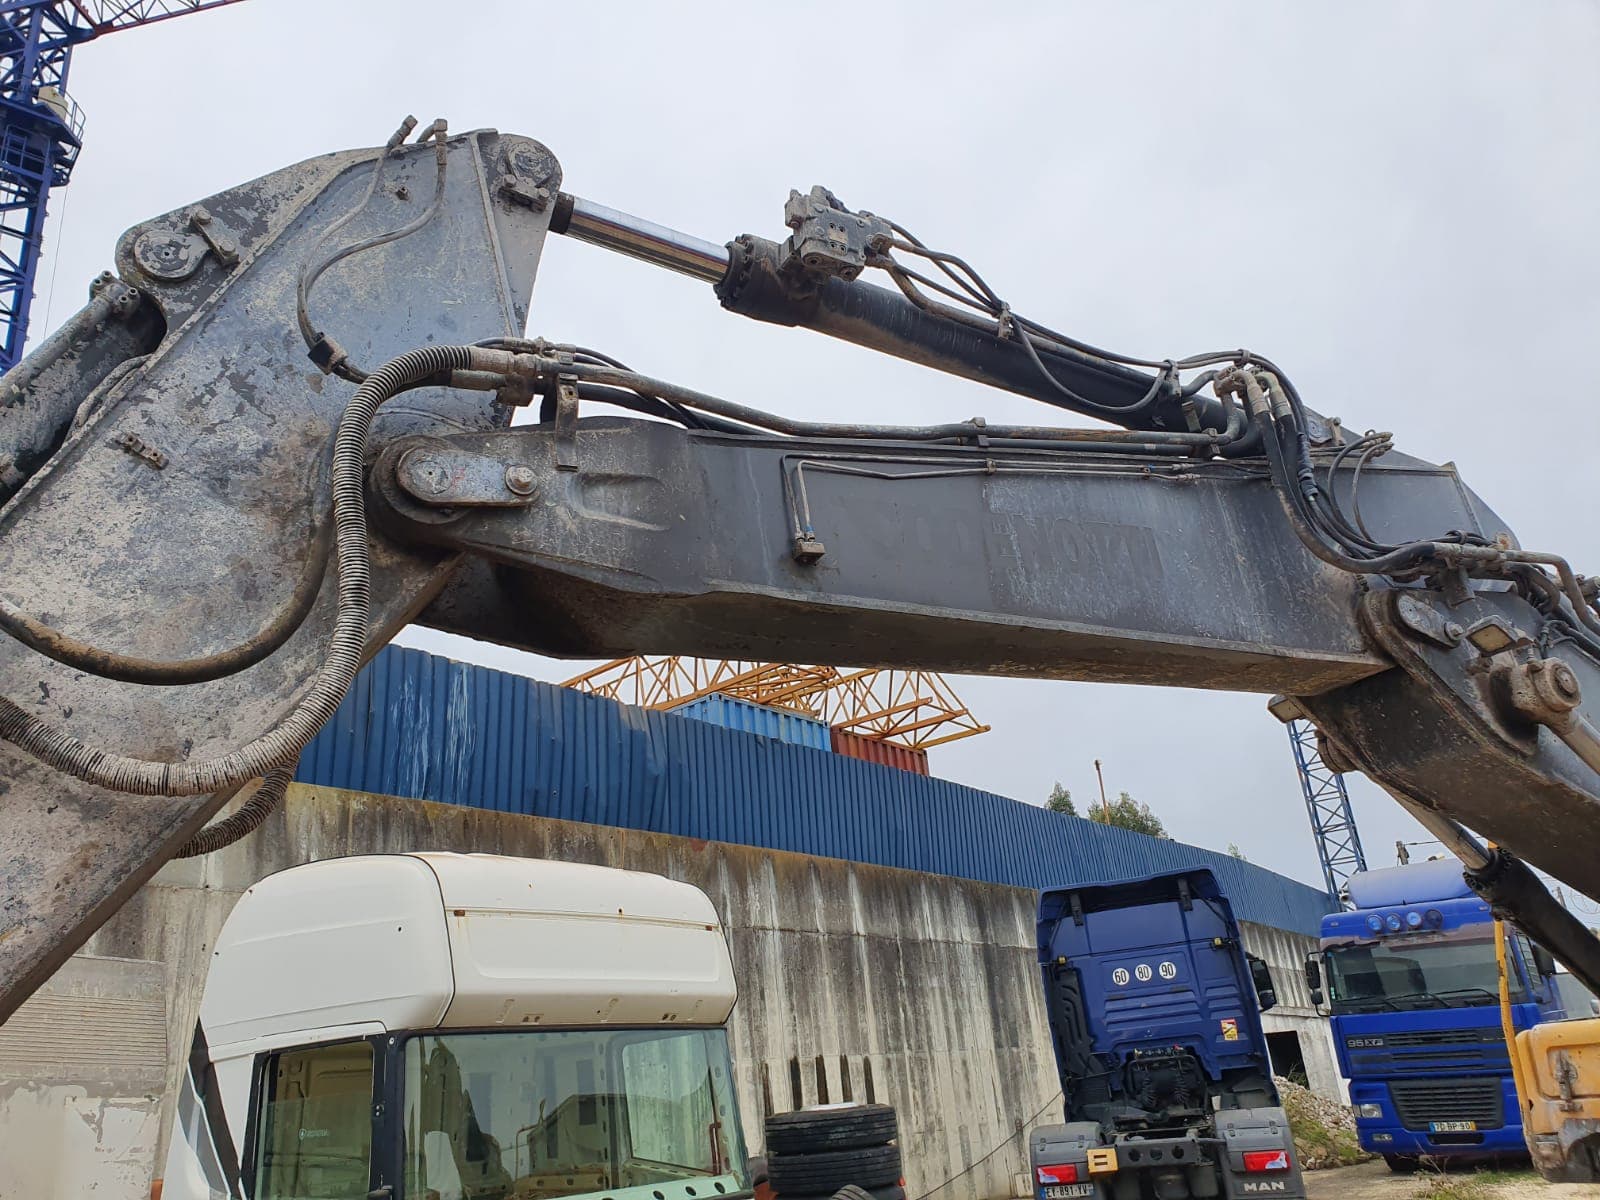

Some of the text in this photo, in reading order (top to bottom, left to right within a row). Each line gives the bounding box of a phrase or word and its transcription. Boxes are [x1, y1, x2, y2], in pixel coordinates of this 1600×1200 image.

[1115, 963, 1174, 983] 60 80 90
[1243, 1181, 1285, 1192] MAN
